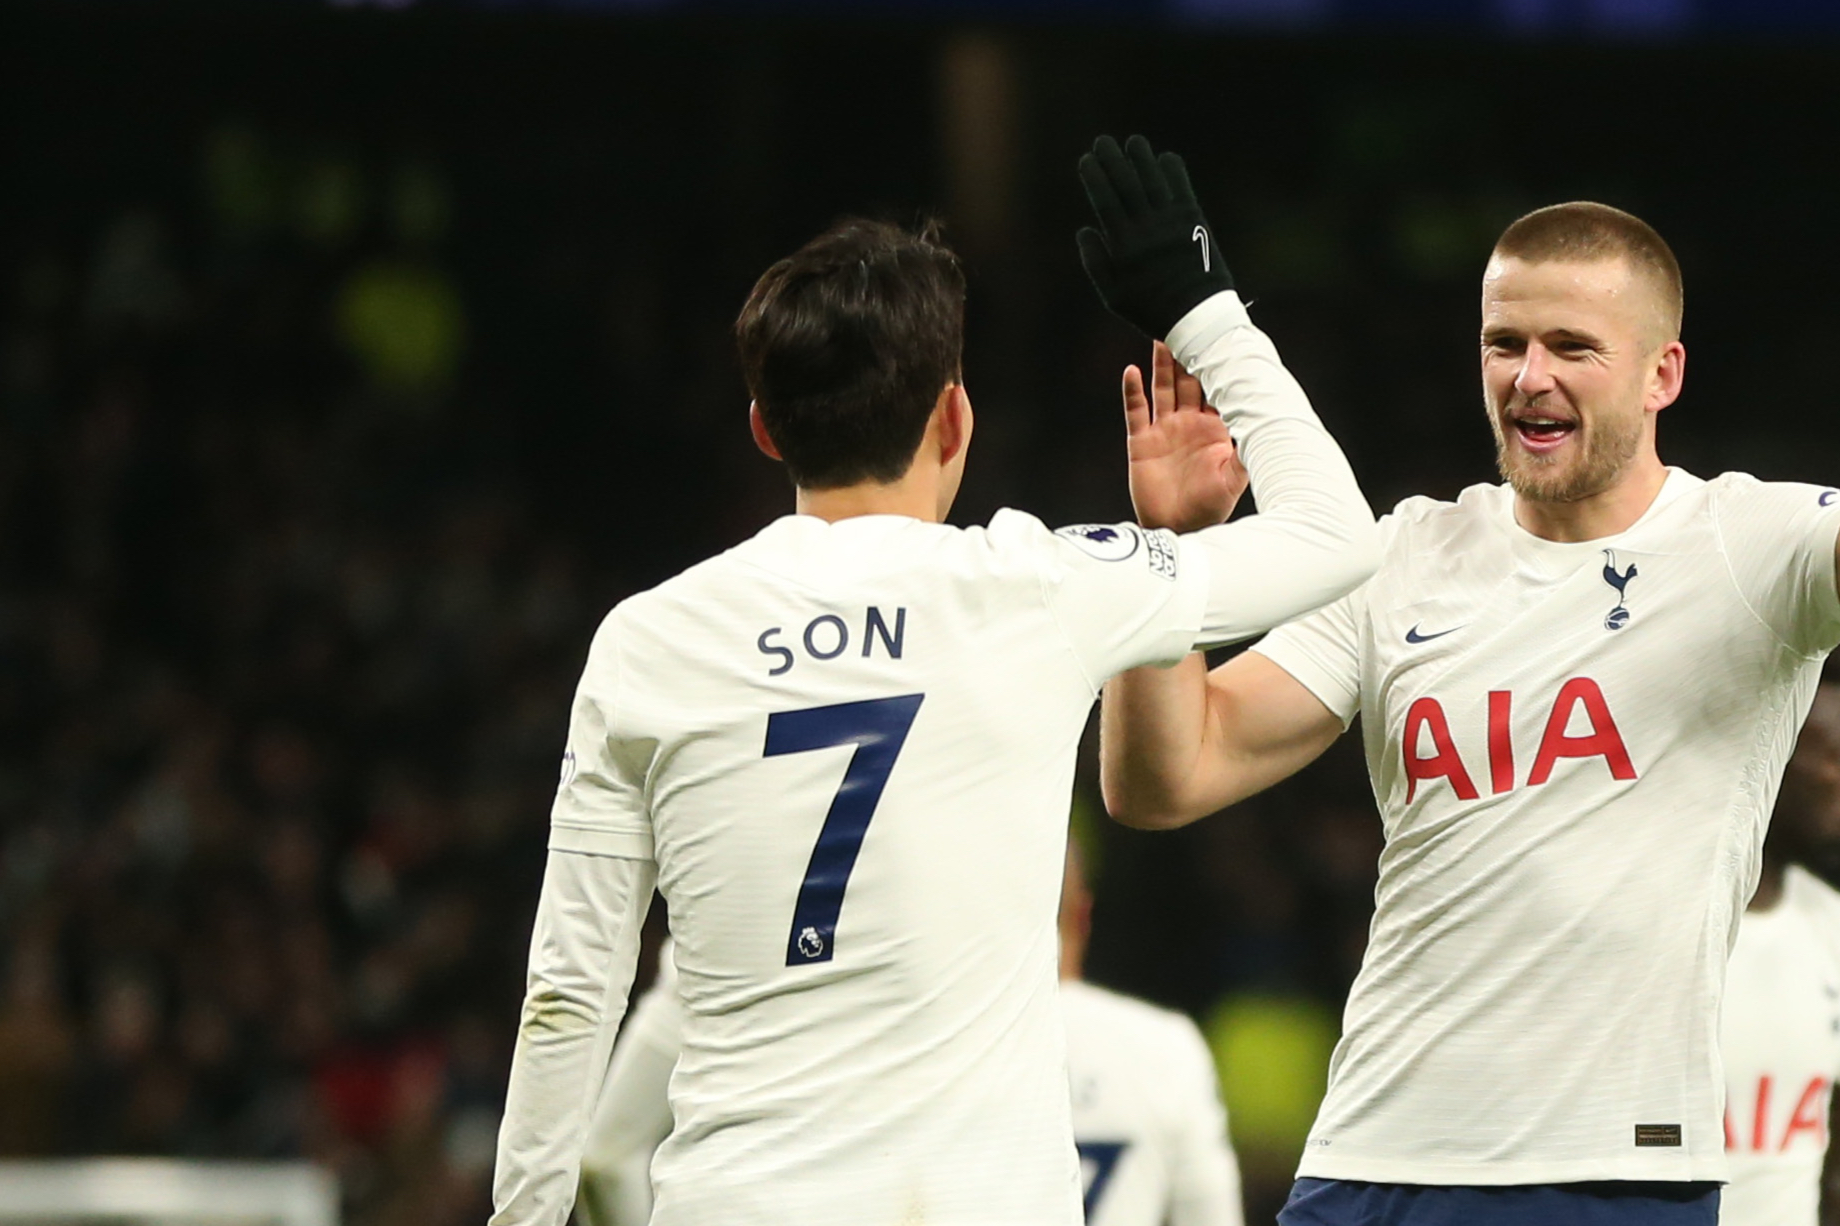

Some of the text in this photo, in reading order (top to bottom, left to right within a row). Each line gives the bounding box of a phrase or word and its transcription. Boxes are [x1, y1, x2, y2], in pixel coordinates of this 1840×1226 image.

[757, 606, 907, 676] SON
[1402, 676, 1638, 806] AIA
[762, 692, 926, 967] 7
[1723, 1075, 1830, 1152] IA
